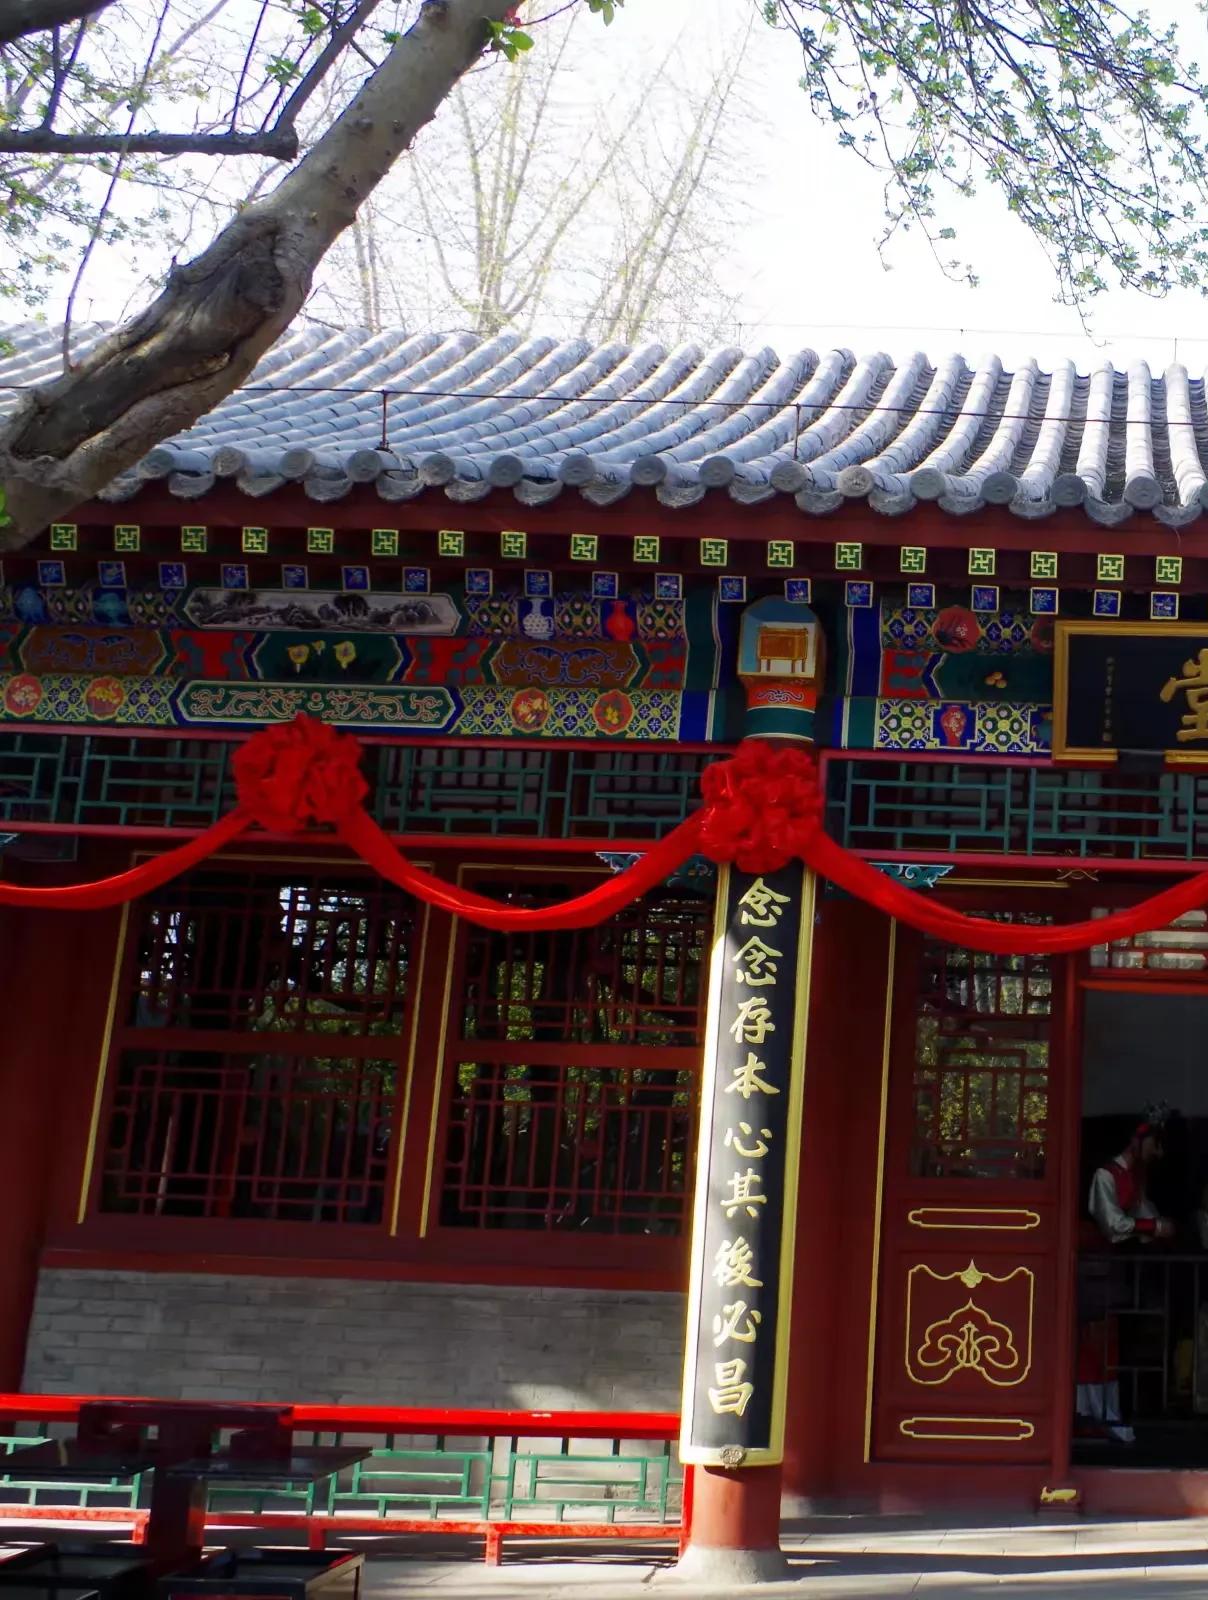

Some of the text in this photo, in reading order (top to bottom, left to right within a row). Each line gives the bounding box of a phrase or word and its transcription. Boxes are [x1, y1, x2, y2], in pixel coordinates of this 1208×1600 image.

[706, 876, 791, 1418] 念念存本心其後必昌
